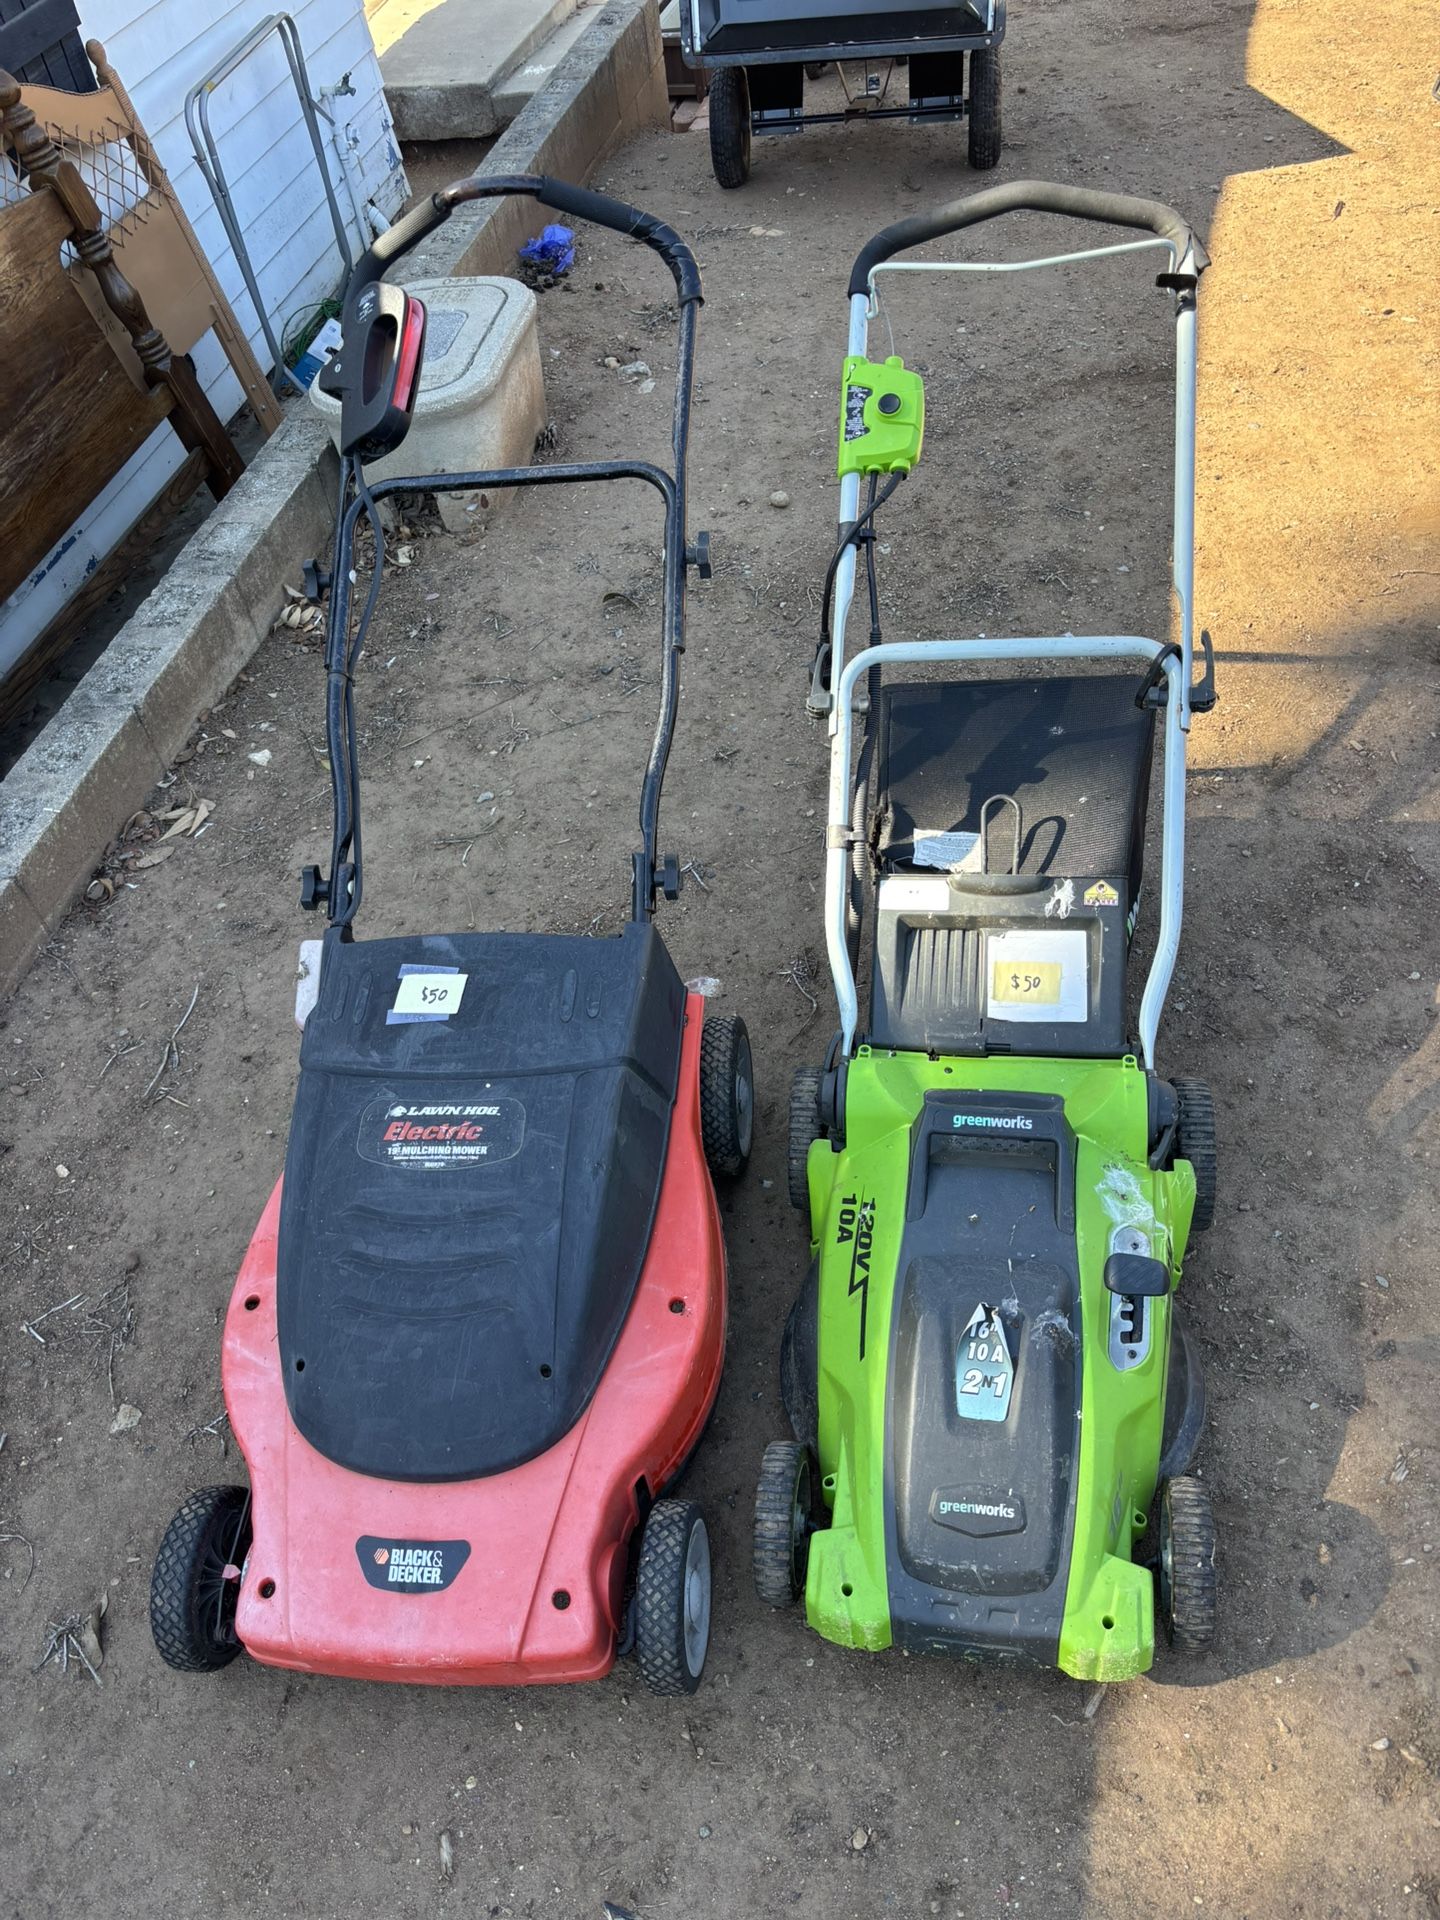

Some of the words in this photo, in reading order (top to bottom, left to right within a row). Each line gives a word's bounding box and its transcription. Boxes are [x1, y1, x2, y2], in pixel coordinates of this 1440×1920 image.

[1010, 973, 1042, 992] $50
[421, 986, 449, 1004] $50
[407, 1105, 463, 1117] LAWN
[383, 1120, 484, 1141] Electric
[952, 1113, 1033, 1131] greenworks
[401, 1145, 451, 1156] MULCHING
[452, 1145, 488, 1156] MOWER
[837, 1193, 858, 1244] 10A
[856, 1197, 876, 1272] 120V
[967, 1342, 989, 1361] 10
[939, 1499, 1016, 1519] greenworks
